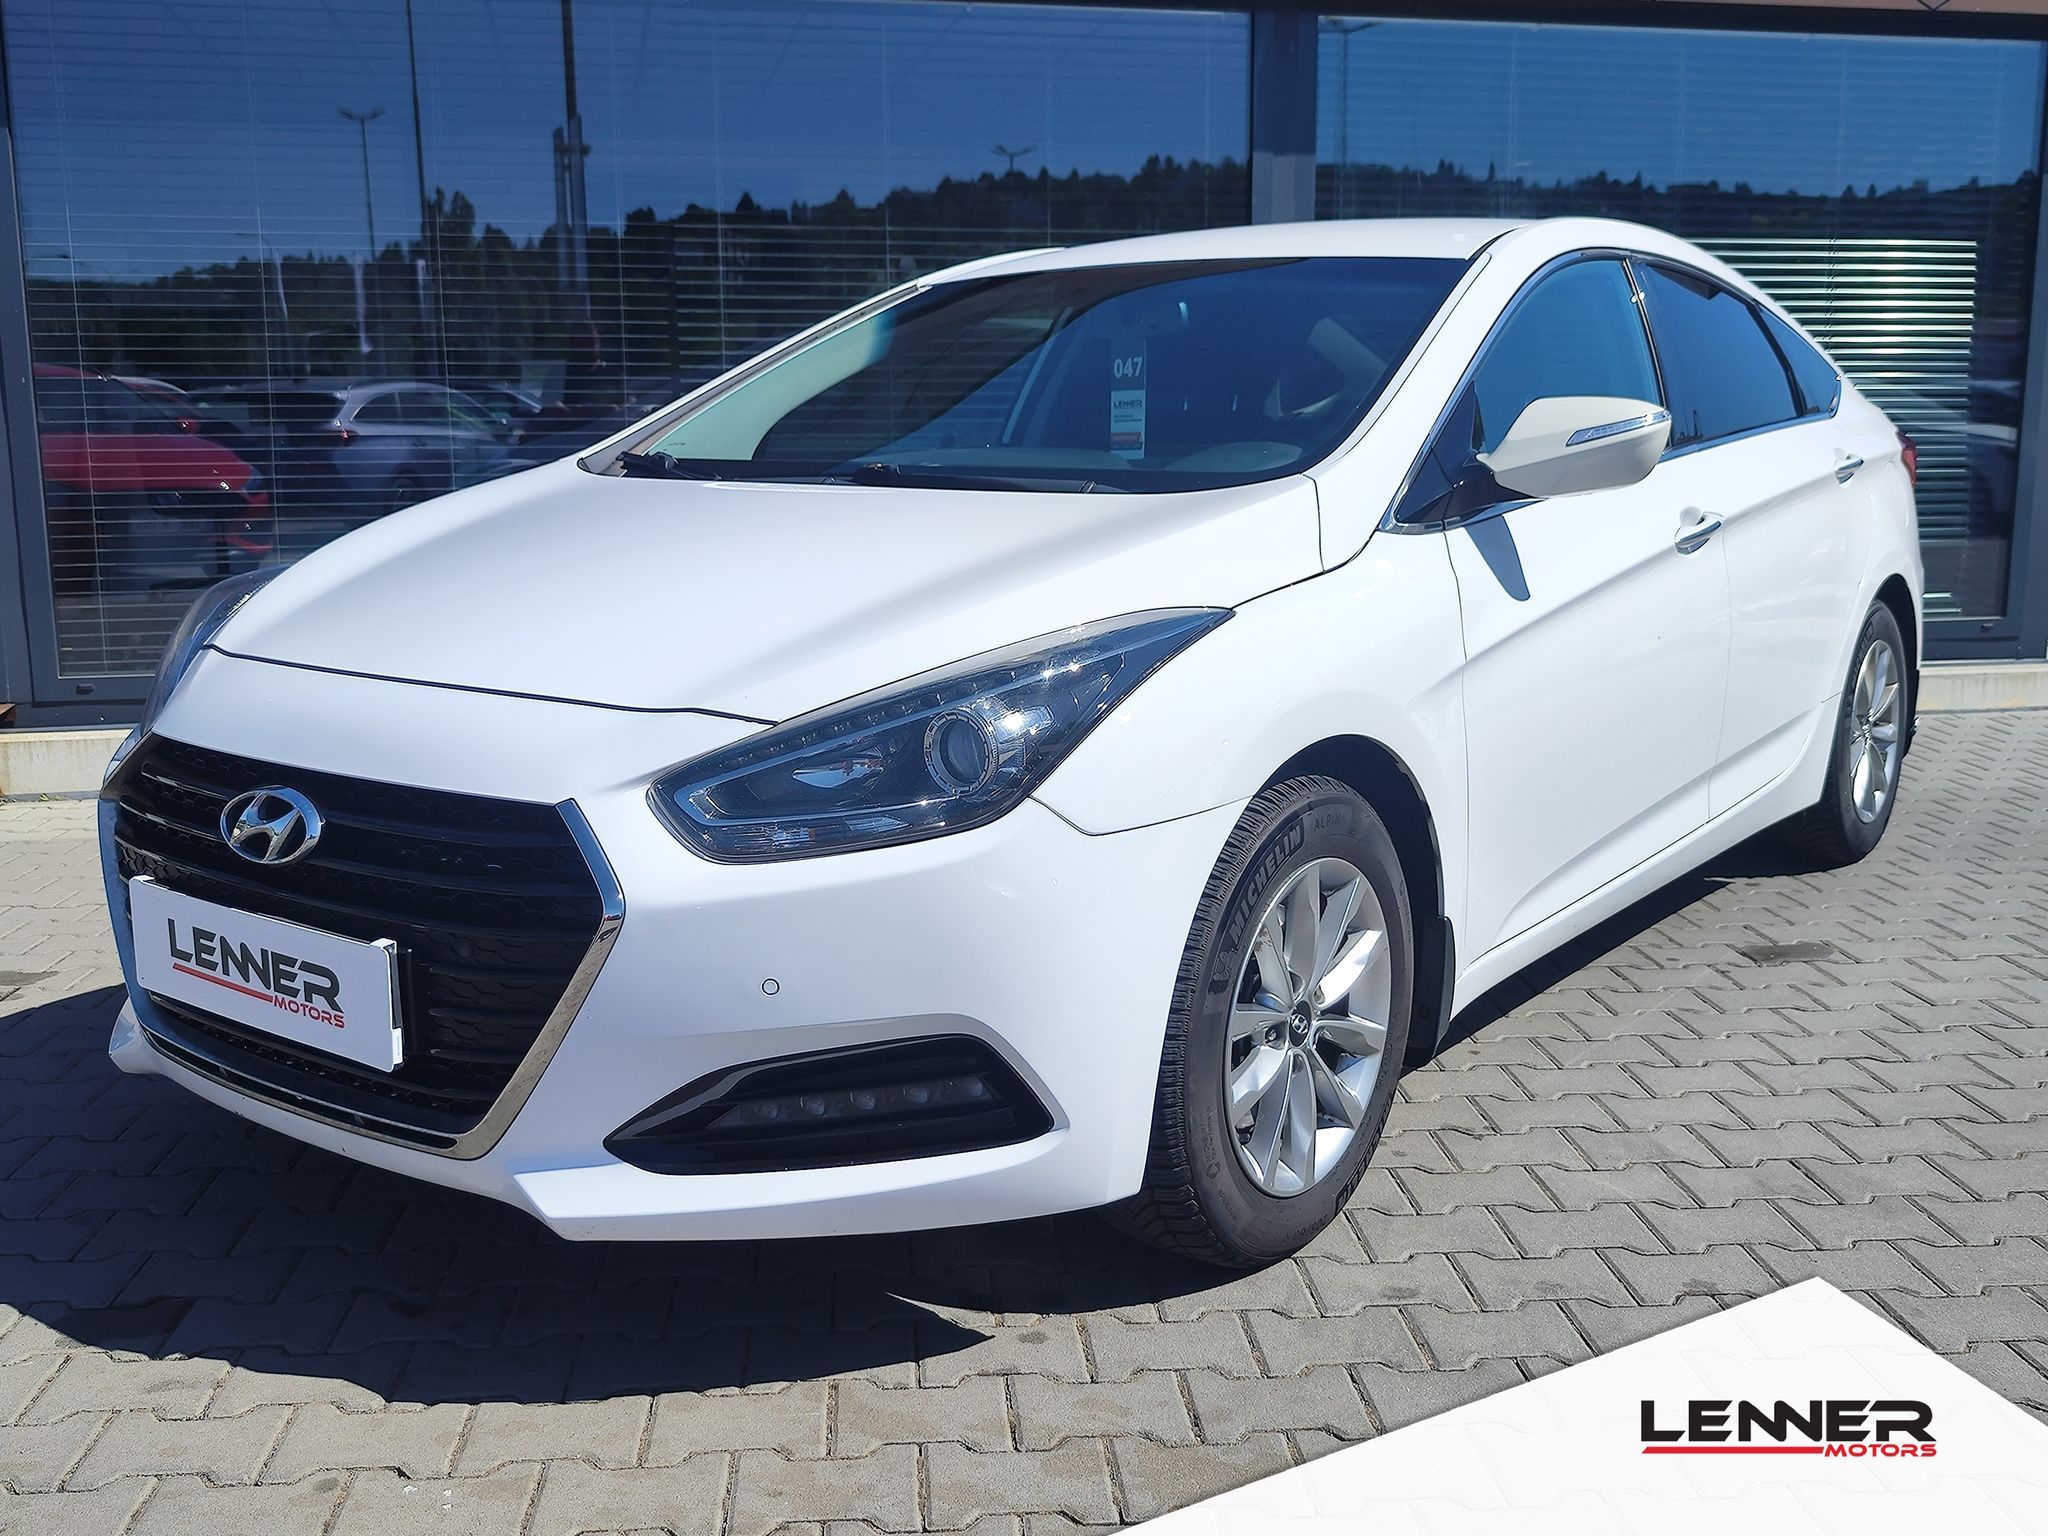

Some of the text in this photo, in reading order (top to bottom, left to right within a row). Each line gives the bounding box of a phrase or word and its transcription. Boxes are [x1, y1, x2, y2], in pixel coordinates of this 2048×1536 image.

[1113, 357, 1143, 378] 047
[1229, 824, 1304, 946] MICHELIN
[168, 918, 344, 1013] LENNER
[273, 995, 345, 1029] MOTORS
